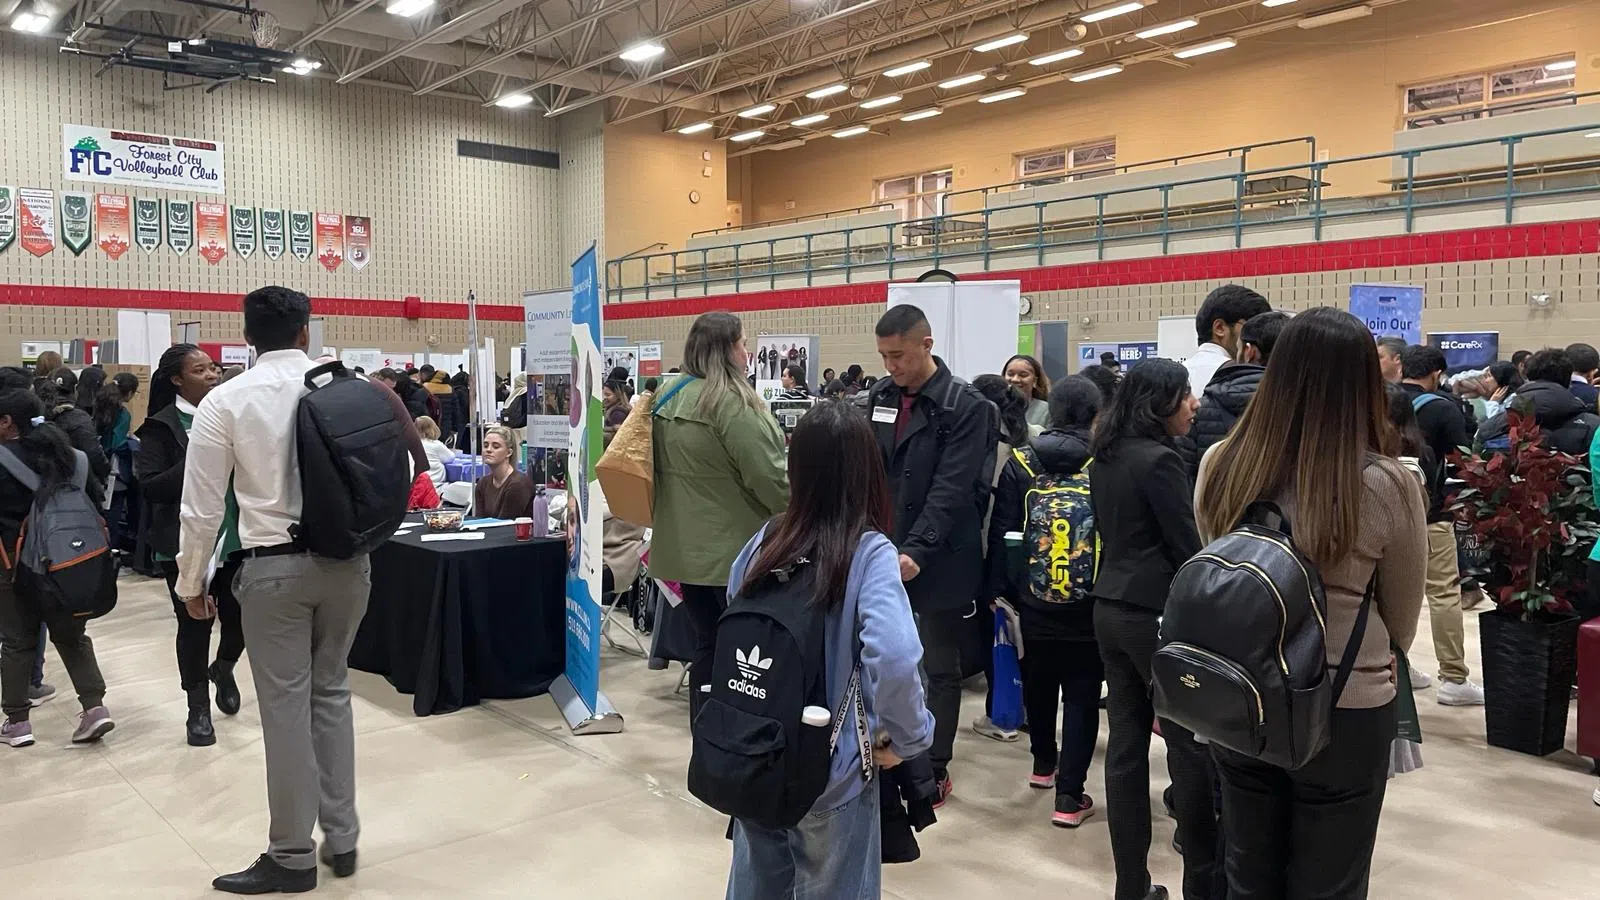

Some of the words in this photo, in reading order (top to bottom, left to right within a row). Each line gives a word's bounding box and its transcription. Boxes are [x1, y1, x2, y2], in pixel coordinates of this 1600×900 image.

[129, 144, 171, 162] Forest
[177, 151, 201, 165] City
[113, 158, 183, 179] Volleyball
[190, 166, 218, 181] Club
[527, 310, 564, 321] COMMUNITY
[1366, 317, 1386, 330] Join
[1390, 318, 1412, 331] Our
[1451, 341, 1482, 349] CareRx
[1121, 350, 1139, 360] HERE
[1049, 519, 1070, 600] OAKLEY
[728, 678, 767, 700] adidas
